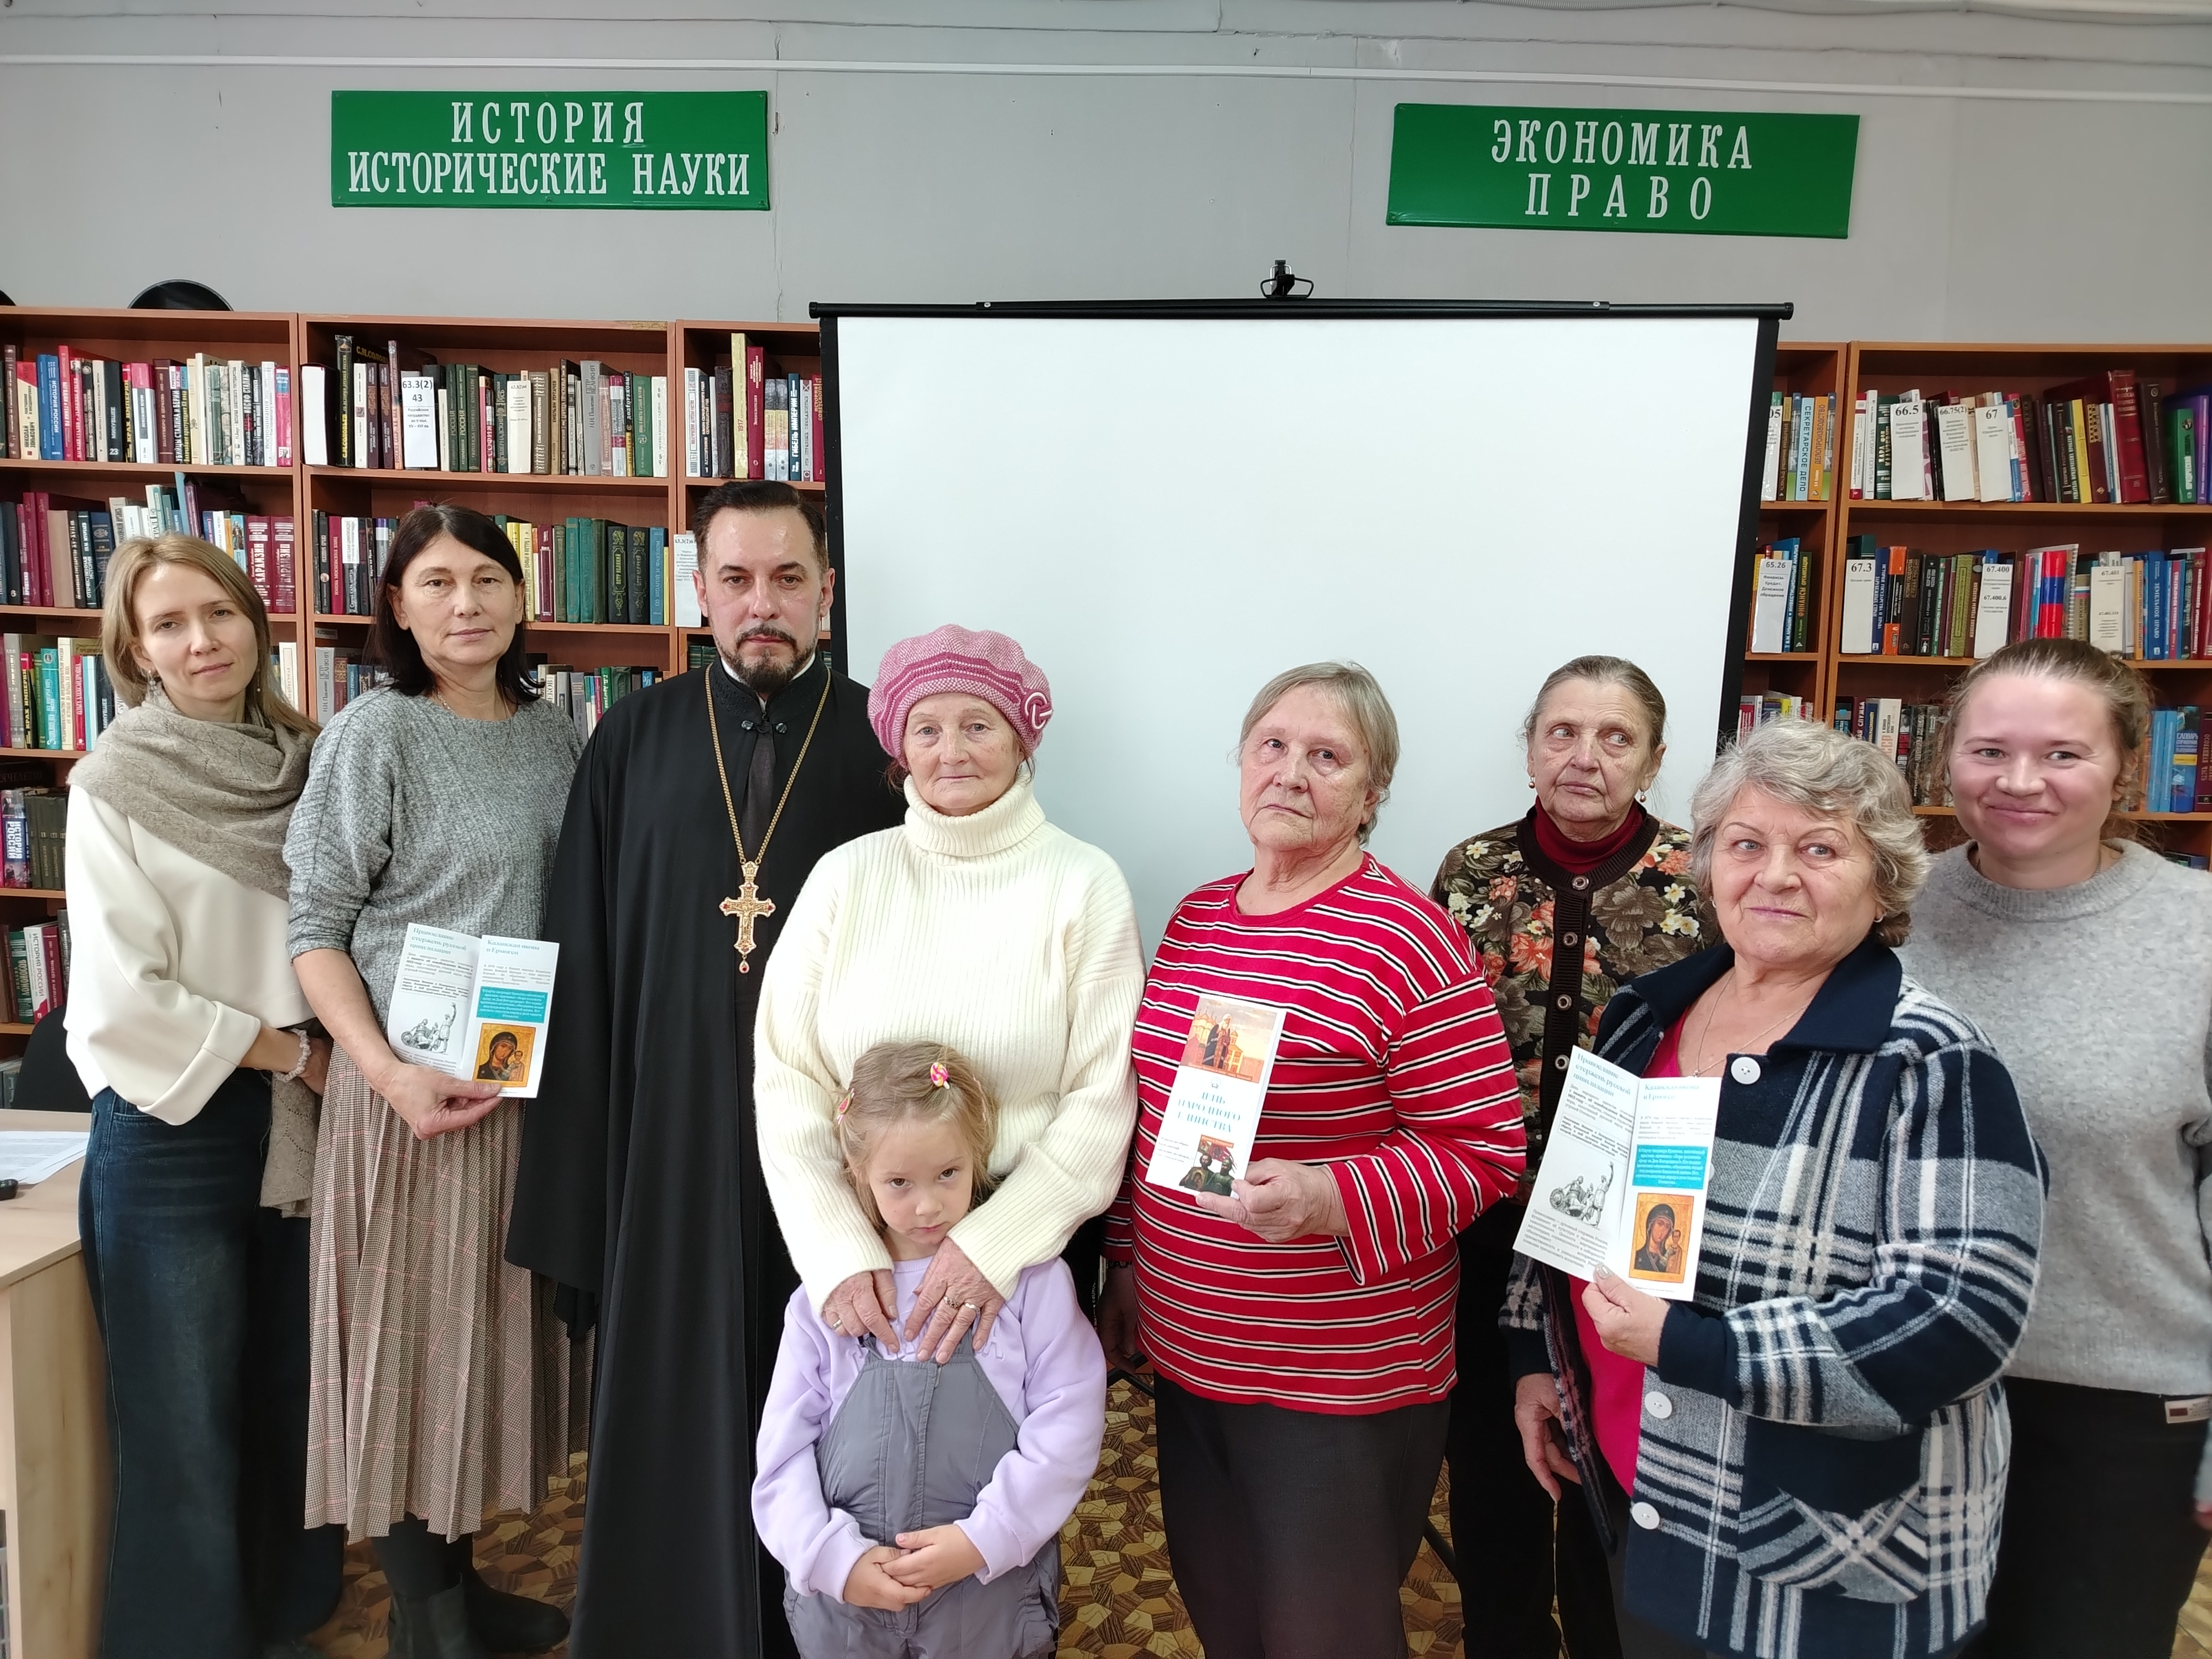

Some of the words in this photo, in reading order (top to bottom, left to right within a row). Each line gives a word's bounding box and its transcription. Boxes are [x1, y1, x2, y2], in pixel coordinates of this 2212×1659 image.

[451, 101, 644, 144] ИСТОРИЯ
[1491, 119, 1752, 169] ЭКОНОМИКА
[347, 152, 607, 195] ИСТОРИЧЕСКИЕ
[632, 153, 750, 195] НАУКИ
[1524, 173, 1713, 220] ПРАВО
[242, 374, 251, 393] СТАЛИН
[403, 379, 432, 390] 63.3(2)
[172, 390, 180, 408] БЕРИИ
[243, 394, 252, 414] ИОСИФ
[412, 394, 423, 402] 43
[1895, 404, 1919, 416] 66.5
[1939, 405, 1967, 415] 66.75(2)
[173, 413, 182, 438] СТАЛИНА
[1985, 409, 1998, 419] 67
[1801, 406, 1811, 467] СЕКРЕТАРСКОЕ
[1814, 404, 1825, 465] ДЕЛОПРОИЗВОДСТВО
[175, 439, 183, 462] УБИЙЦЫ
[254, 543, 265, 582] КАРАМЗИН
[279, 544, 291, 583] КАРАМЗИН
[1851, 563, 1872, 572] 67.3
[82, 556, 92, 598] ОТЕЧЕСТВЕННАЯ
[1788, 565, 1798, 612] ИНВЕСТИЦИОННЫЙ
[1797, 587, 1806, 617] ФИНАНСЫ
[7, 821, 15, 859] РОССИИ
[14, 821, 22, 859] ИСТОРИЯ
[411, 936, 442, 946] стержень
[442, 941, 467, 951] русской
[413, 927, 455, 941] Православие
[487, 939, 520, 948] Казанская
[33, 933, 41, 967] ИСТОРИЯ
[410, 943, 451, 955] цивилизации
[491, 947, 519, 956] Ермоген
[18, 959, 30, 996] ЛОМОНОСОВ
[36, 968, 44, 997] РОССИИ
[1575, 1063, 1606, 1084] стержень
[1606, 1079, 1631, 1095] русской
[1577, 1053, 1620, 1079] Православие
[1573, 1072, 1615, 1097] цивилизации
